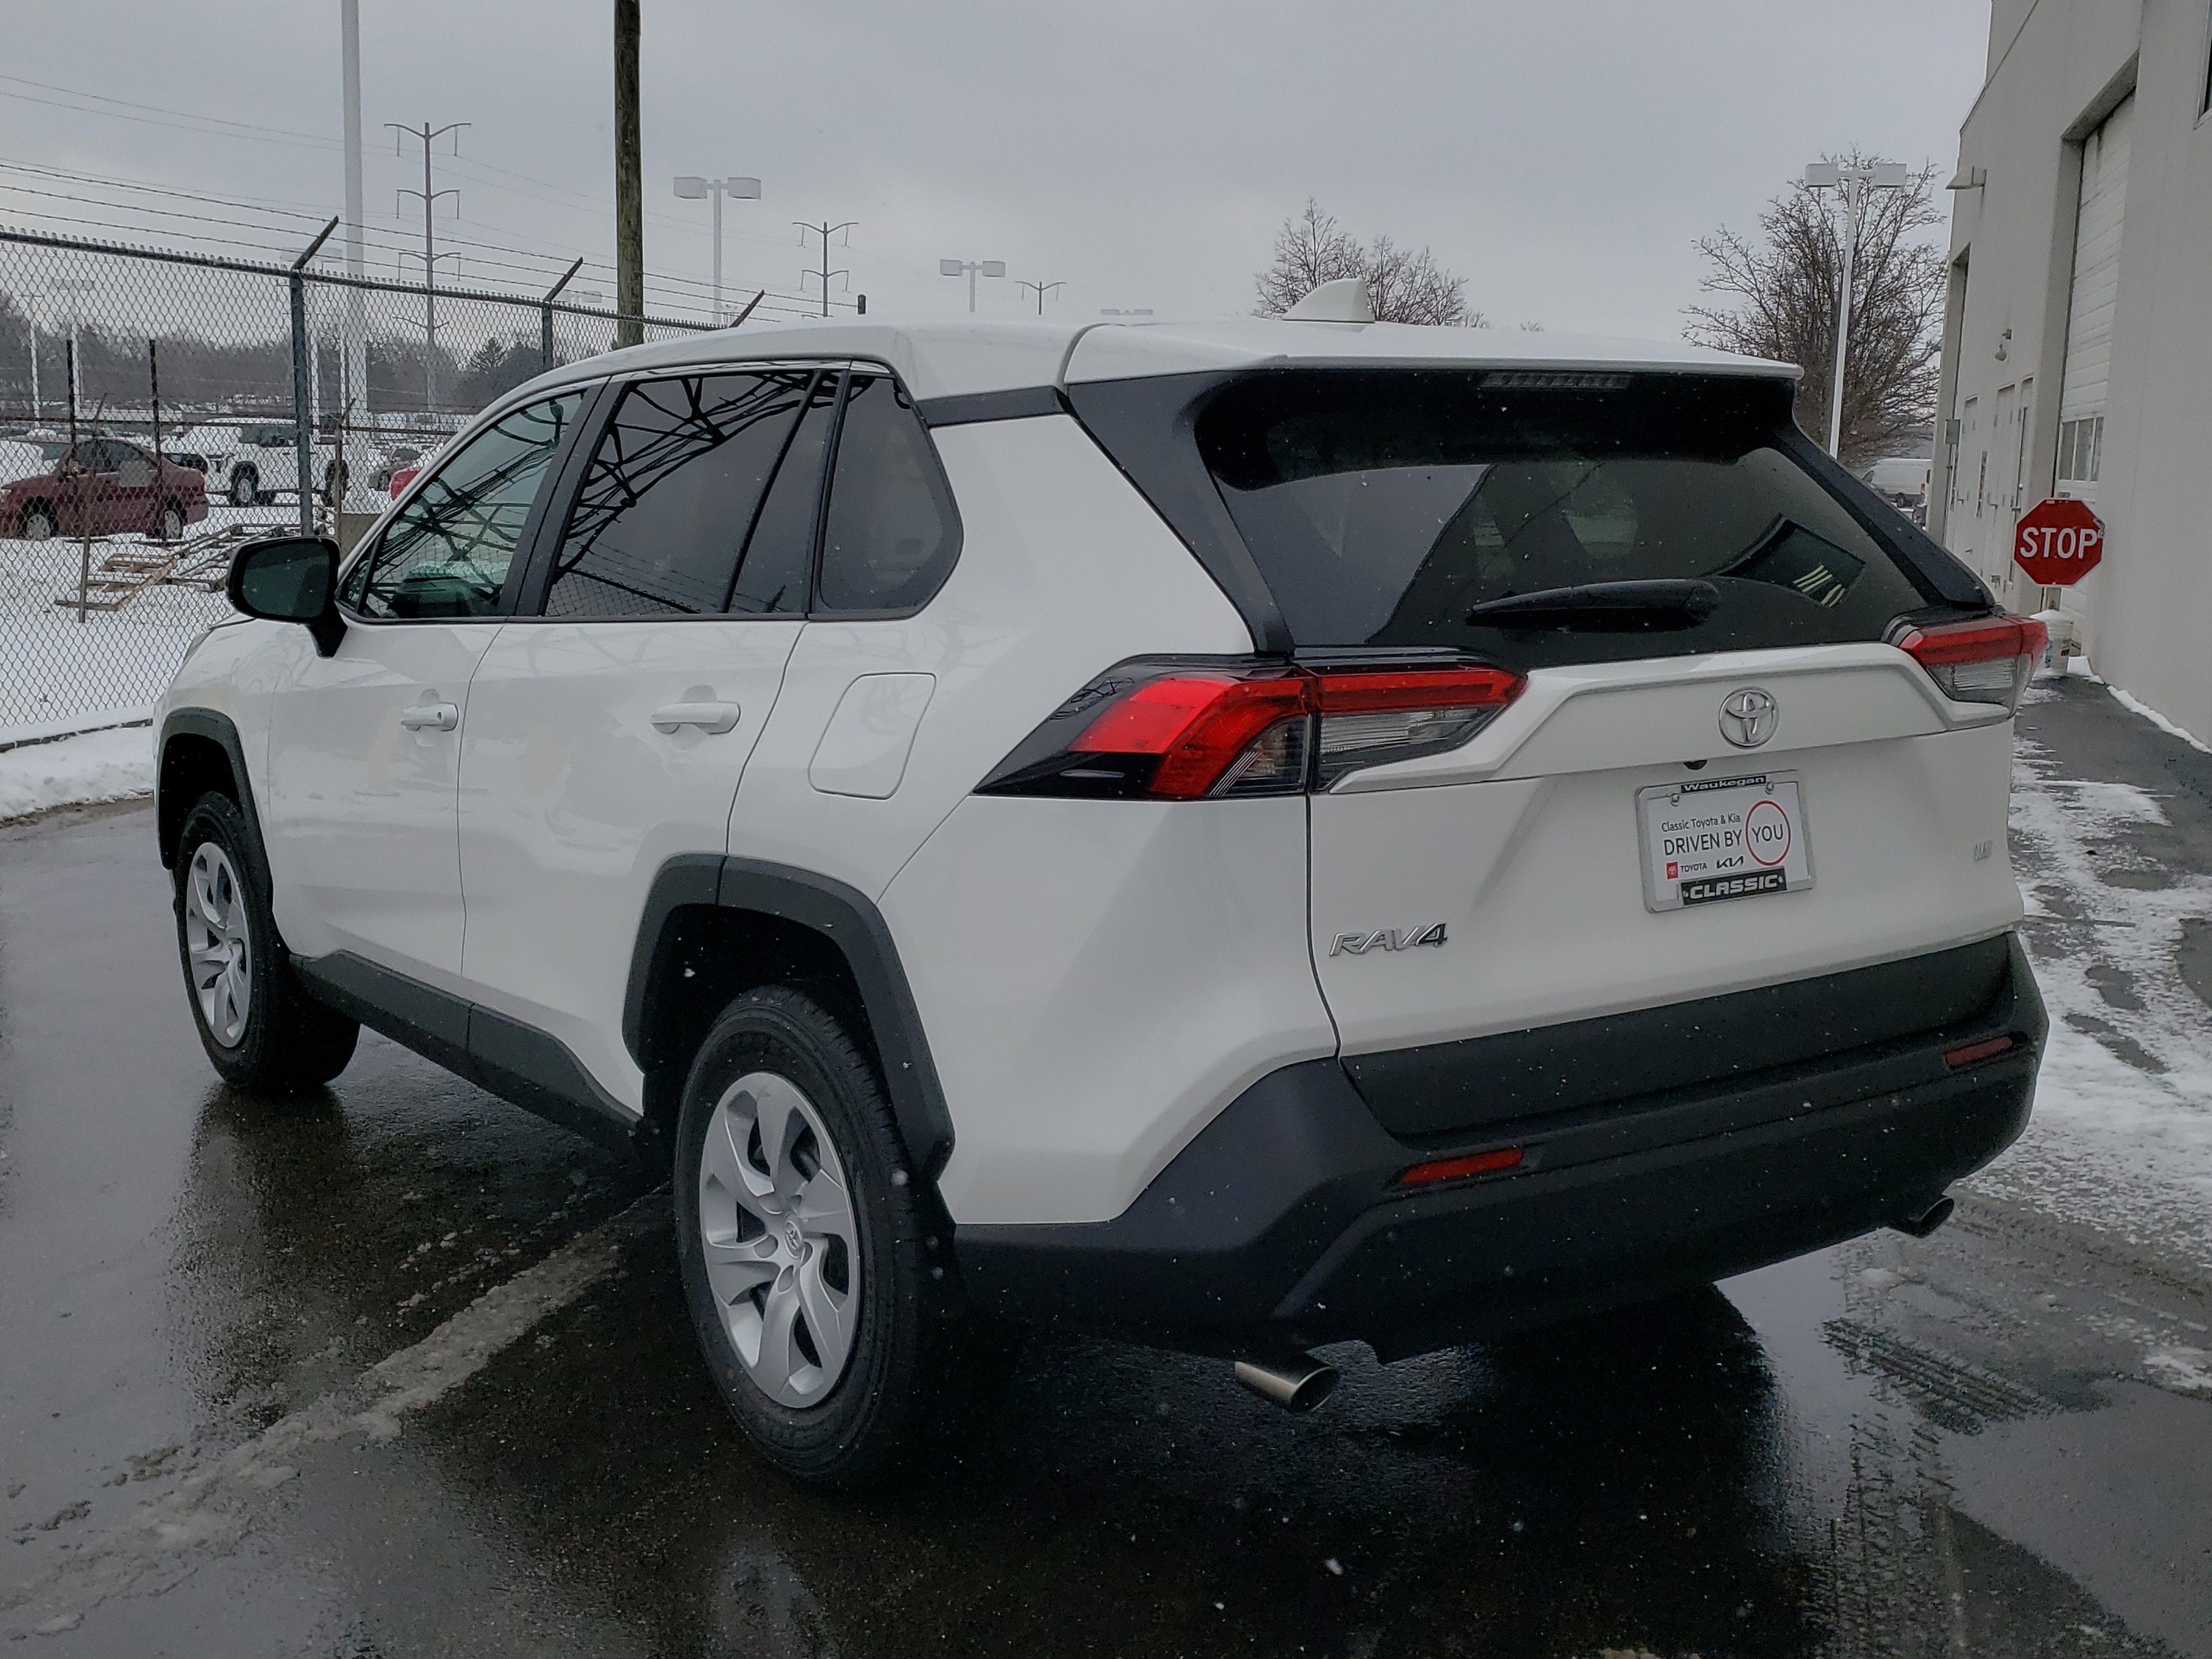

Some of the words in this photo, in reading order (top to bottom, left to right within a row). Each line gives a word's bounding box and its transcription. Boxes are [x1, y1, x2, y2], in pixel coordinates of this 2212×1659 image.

[2020, 527, 2097, 559] STOP
[1684, 777, 1765, 791] Waukegan
[1661, 820, 1689, 833] Classic
[1690, 816, 1718, 830] Toyota
[1720, 815, 1726, 824] &
[1728, 813, 1741, 823] Kia
[1663, 832, 1720, 856] DRIVEN
[1724, 829, 1742, 848] BY
[1751, 823, 1784, 843] YOU
[1680, 862, 1707, 873] TOYOTA
[1690, 874, 1779, 900] CLASSIC
[1329, 922, 1448, 957] RAV4
